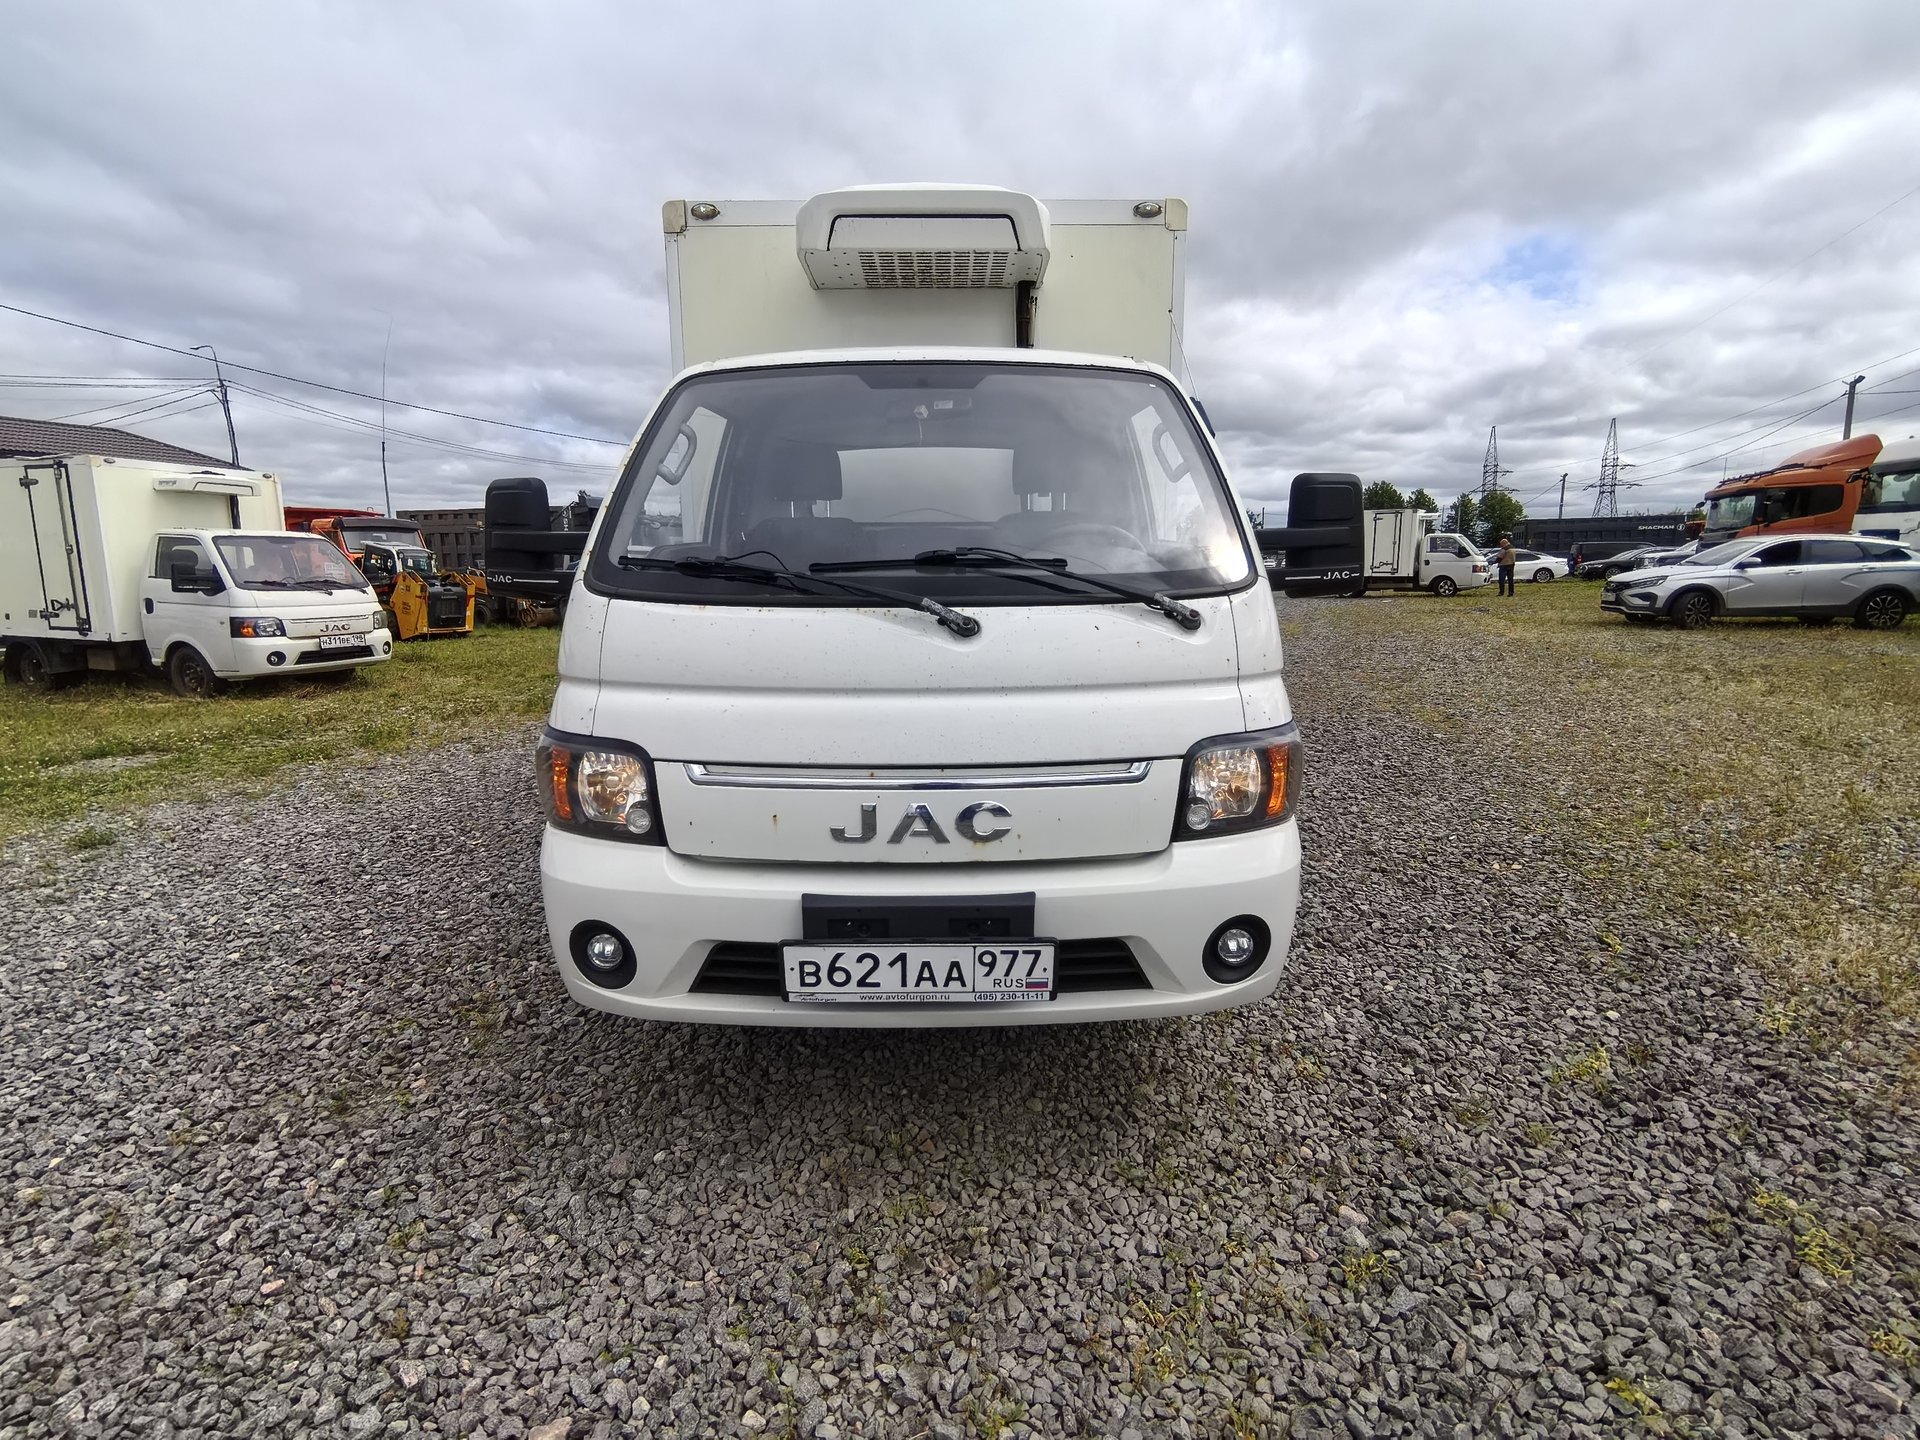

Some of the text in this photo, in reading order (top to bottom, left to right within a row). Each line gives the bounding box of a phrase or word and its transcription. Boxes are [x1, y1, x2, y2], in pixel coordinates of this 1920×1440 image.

[492, 574, 512, 583] JAC
[1323, 570, 1350, 580] JAC
[320, 623, 351, 633] JAC
[830, 800, 1012, 844] JAC
[977, 950, 1042, 977] 977
[993, 978, 1024, 988] RUS
[859, 993, 950, 1001] www.avtofurgon.ru
[973, 992, 1044, 1001] (495) 230-11-11
